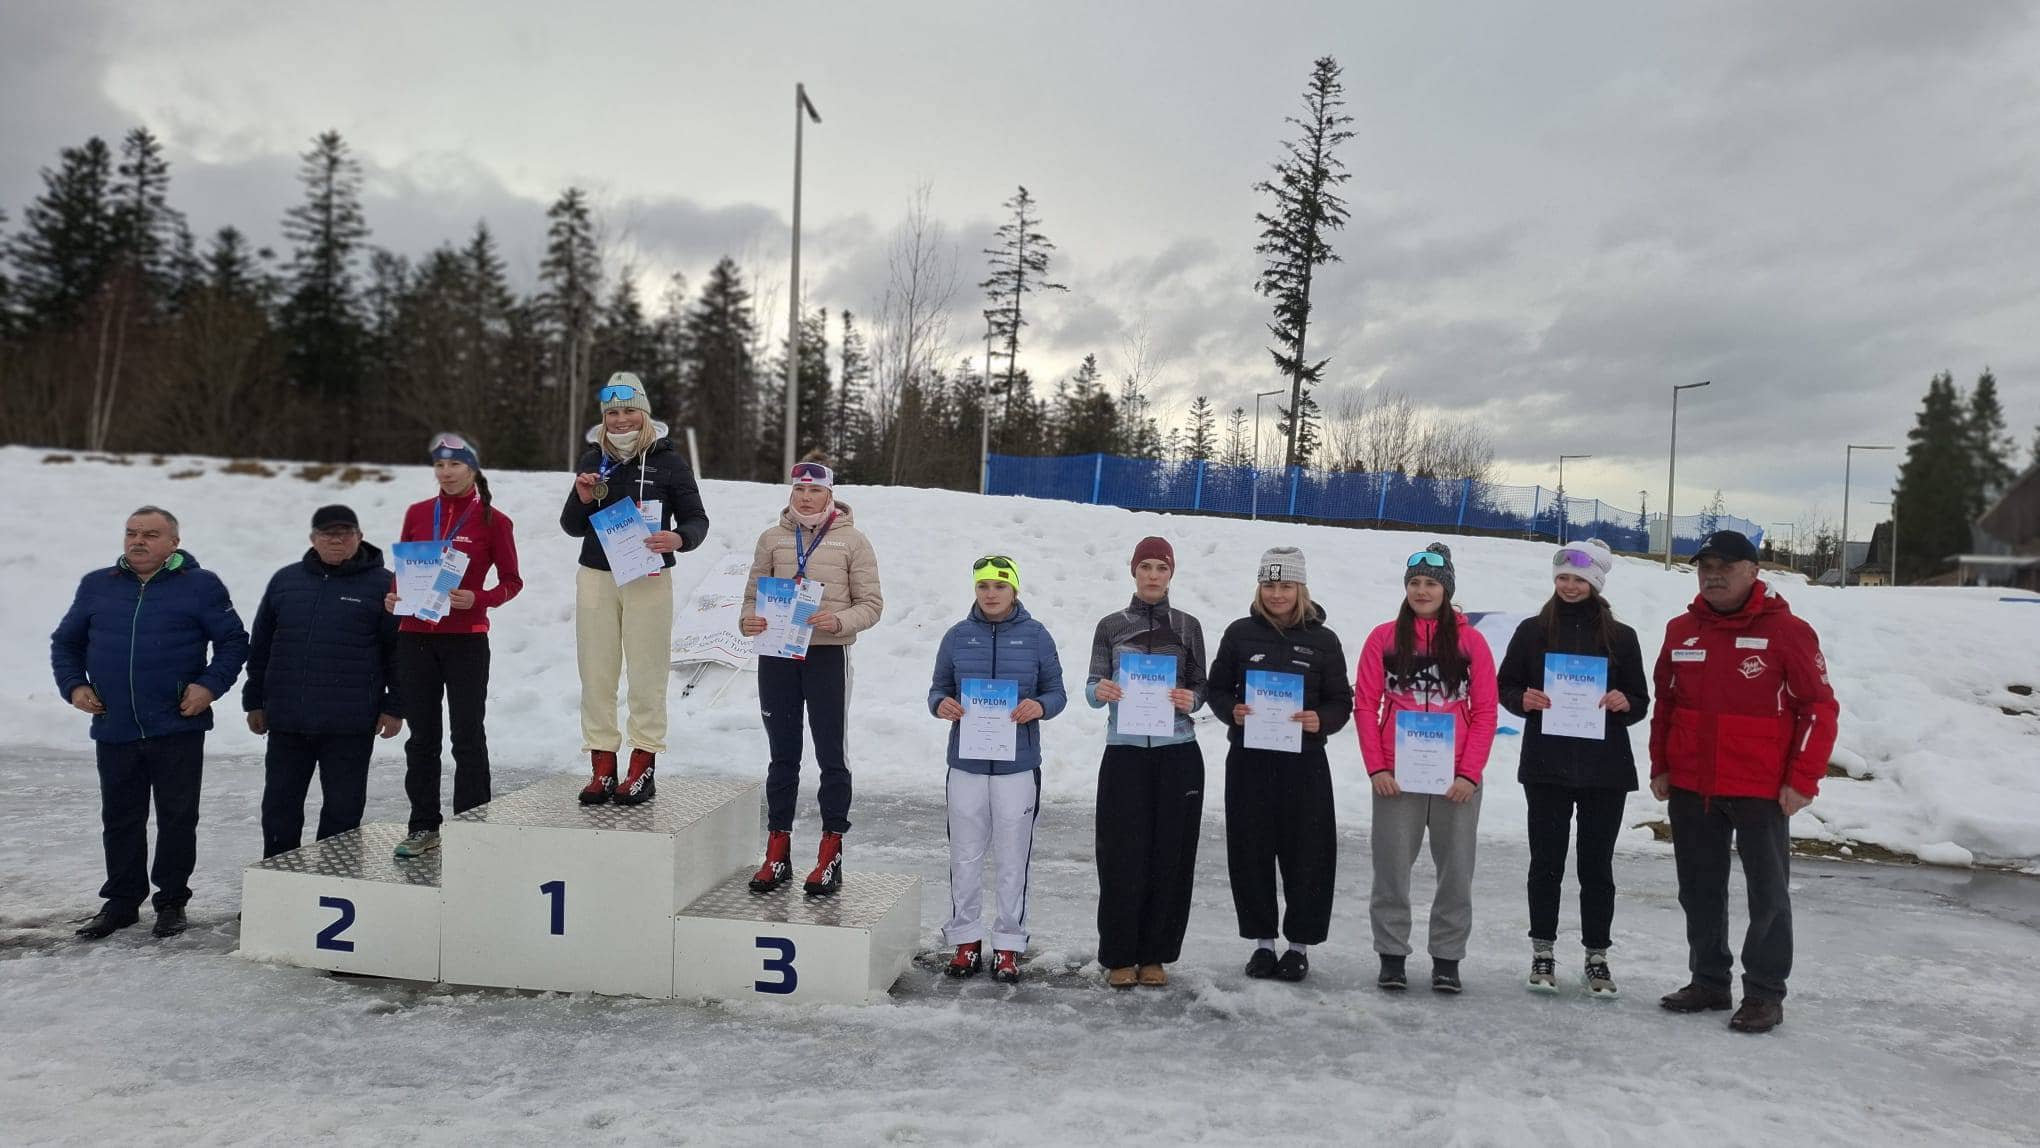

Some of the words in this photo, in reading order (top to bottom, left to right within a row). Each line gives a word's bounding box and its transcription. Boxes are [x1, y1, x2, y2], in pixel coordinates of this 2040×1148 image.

[606, 516, 635, 535] DYPLOM
[1130, 672, 1166, 681] DYPLOM
[1556, 673, 1595, 683] DYPLOM
[1256, 689, 1293, 698] DYPLOM
[972, 697, 1007, 706] DYPLOM
[1407, 729, 1444, 739] DYPLOM
[538, 880, 567, 935] 1
[316, 896, 356, 953] 2
[754, 936, 799, 995] 3
